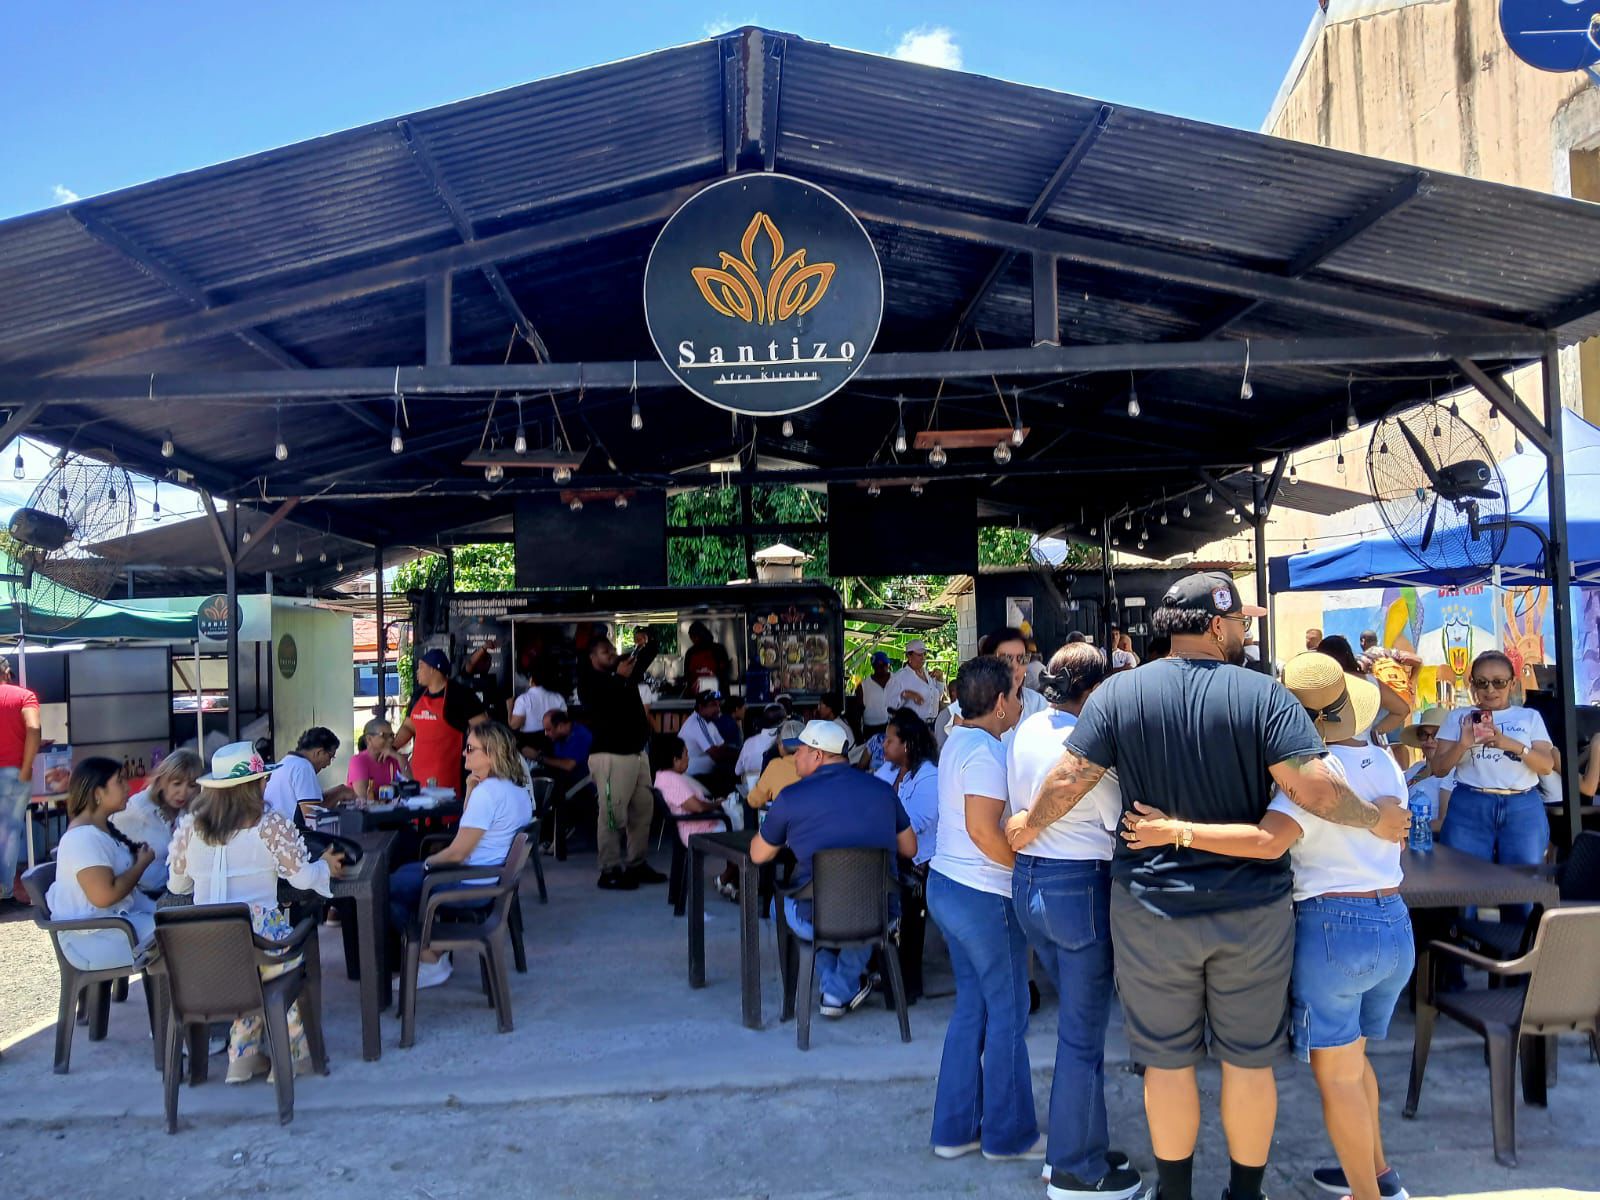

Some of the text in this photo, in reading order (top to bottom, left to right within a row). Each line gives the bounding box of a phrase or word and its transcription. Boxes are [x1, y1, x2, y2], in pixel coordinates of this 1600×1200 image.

[678, 337, 856, 364] Santizo
[719, 371, 818, 382] Afro Kitchen
